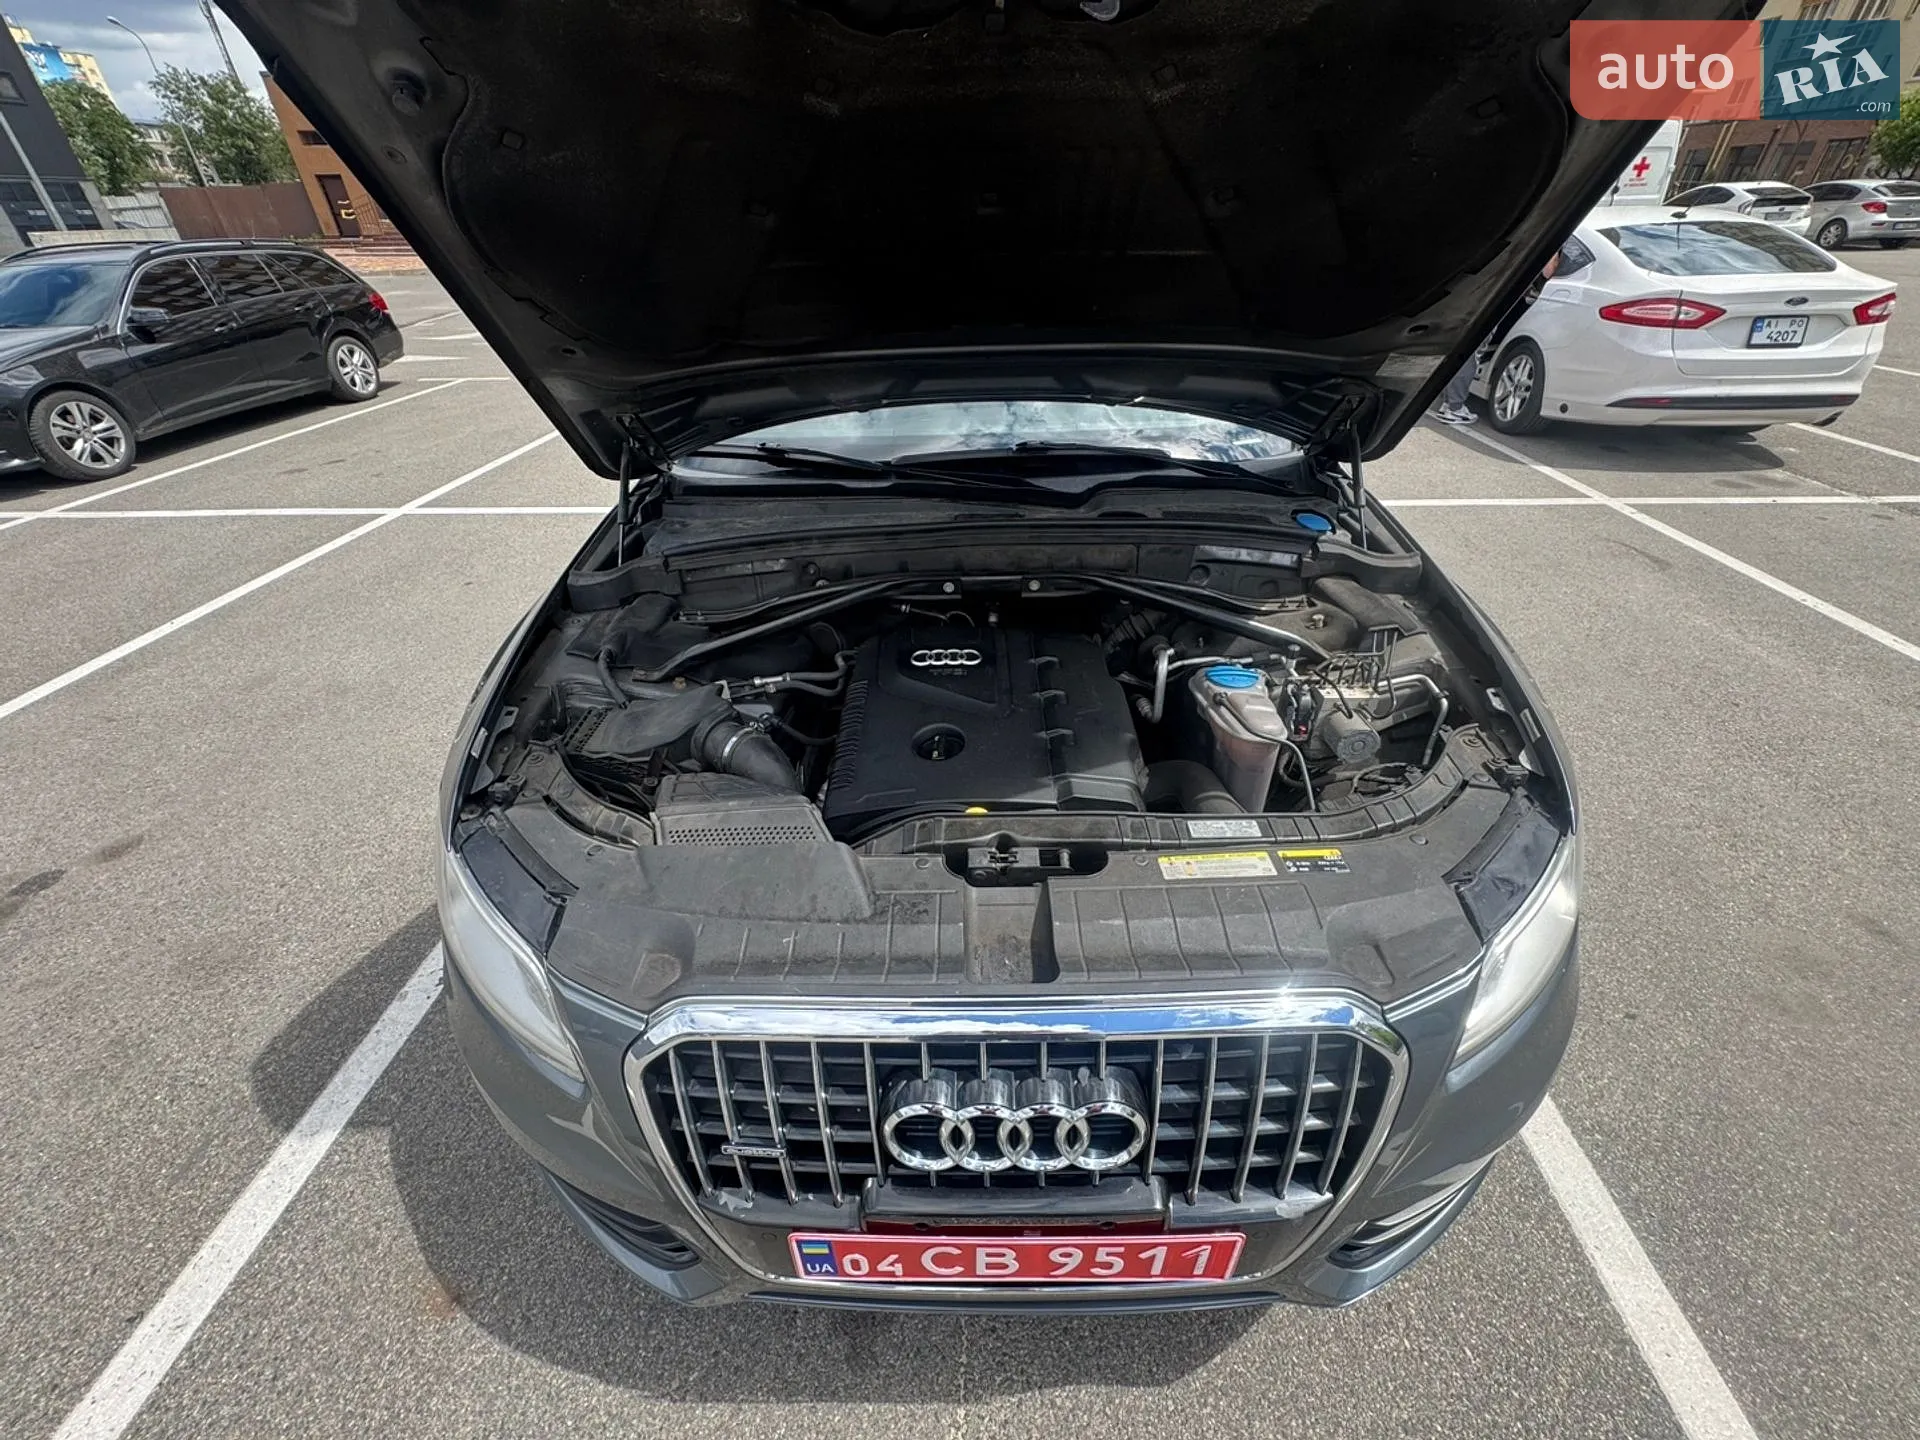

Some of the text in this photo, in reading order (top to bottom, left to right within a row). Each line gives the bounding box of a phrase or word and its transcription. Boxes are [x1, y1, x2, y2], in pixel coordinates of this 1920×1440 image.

[1766, 330, 1798, 342] 4207
[806, 1245, 1212, 1276] UA 04 CB 9511
